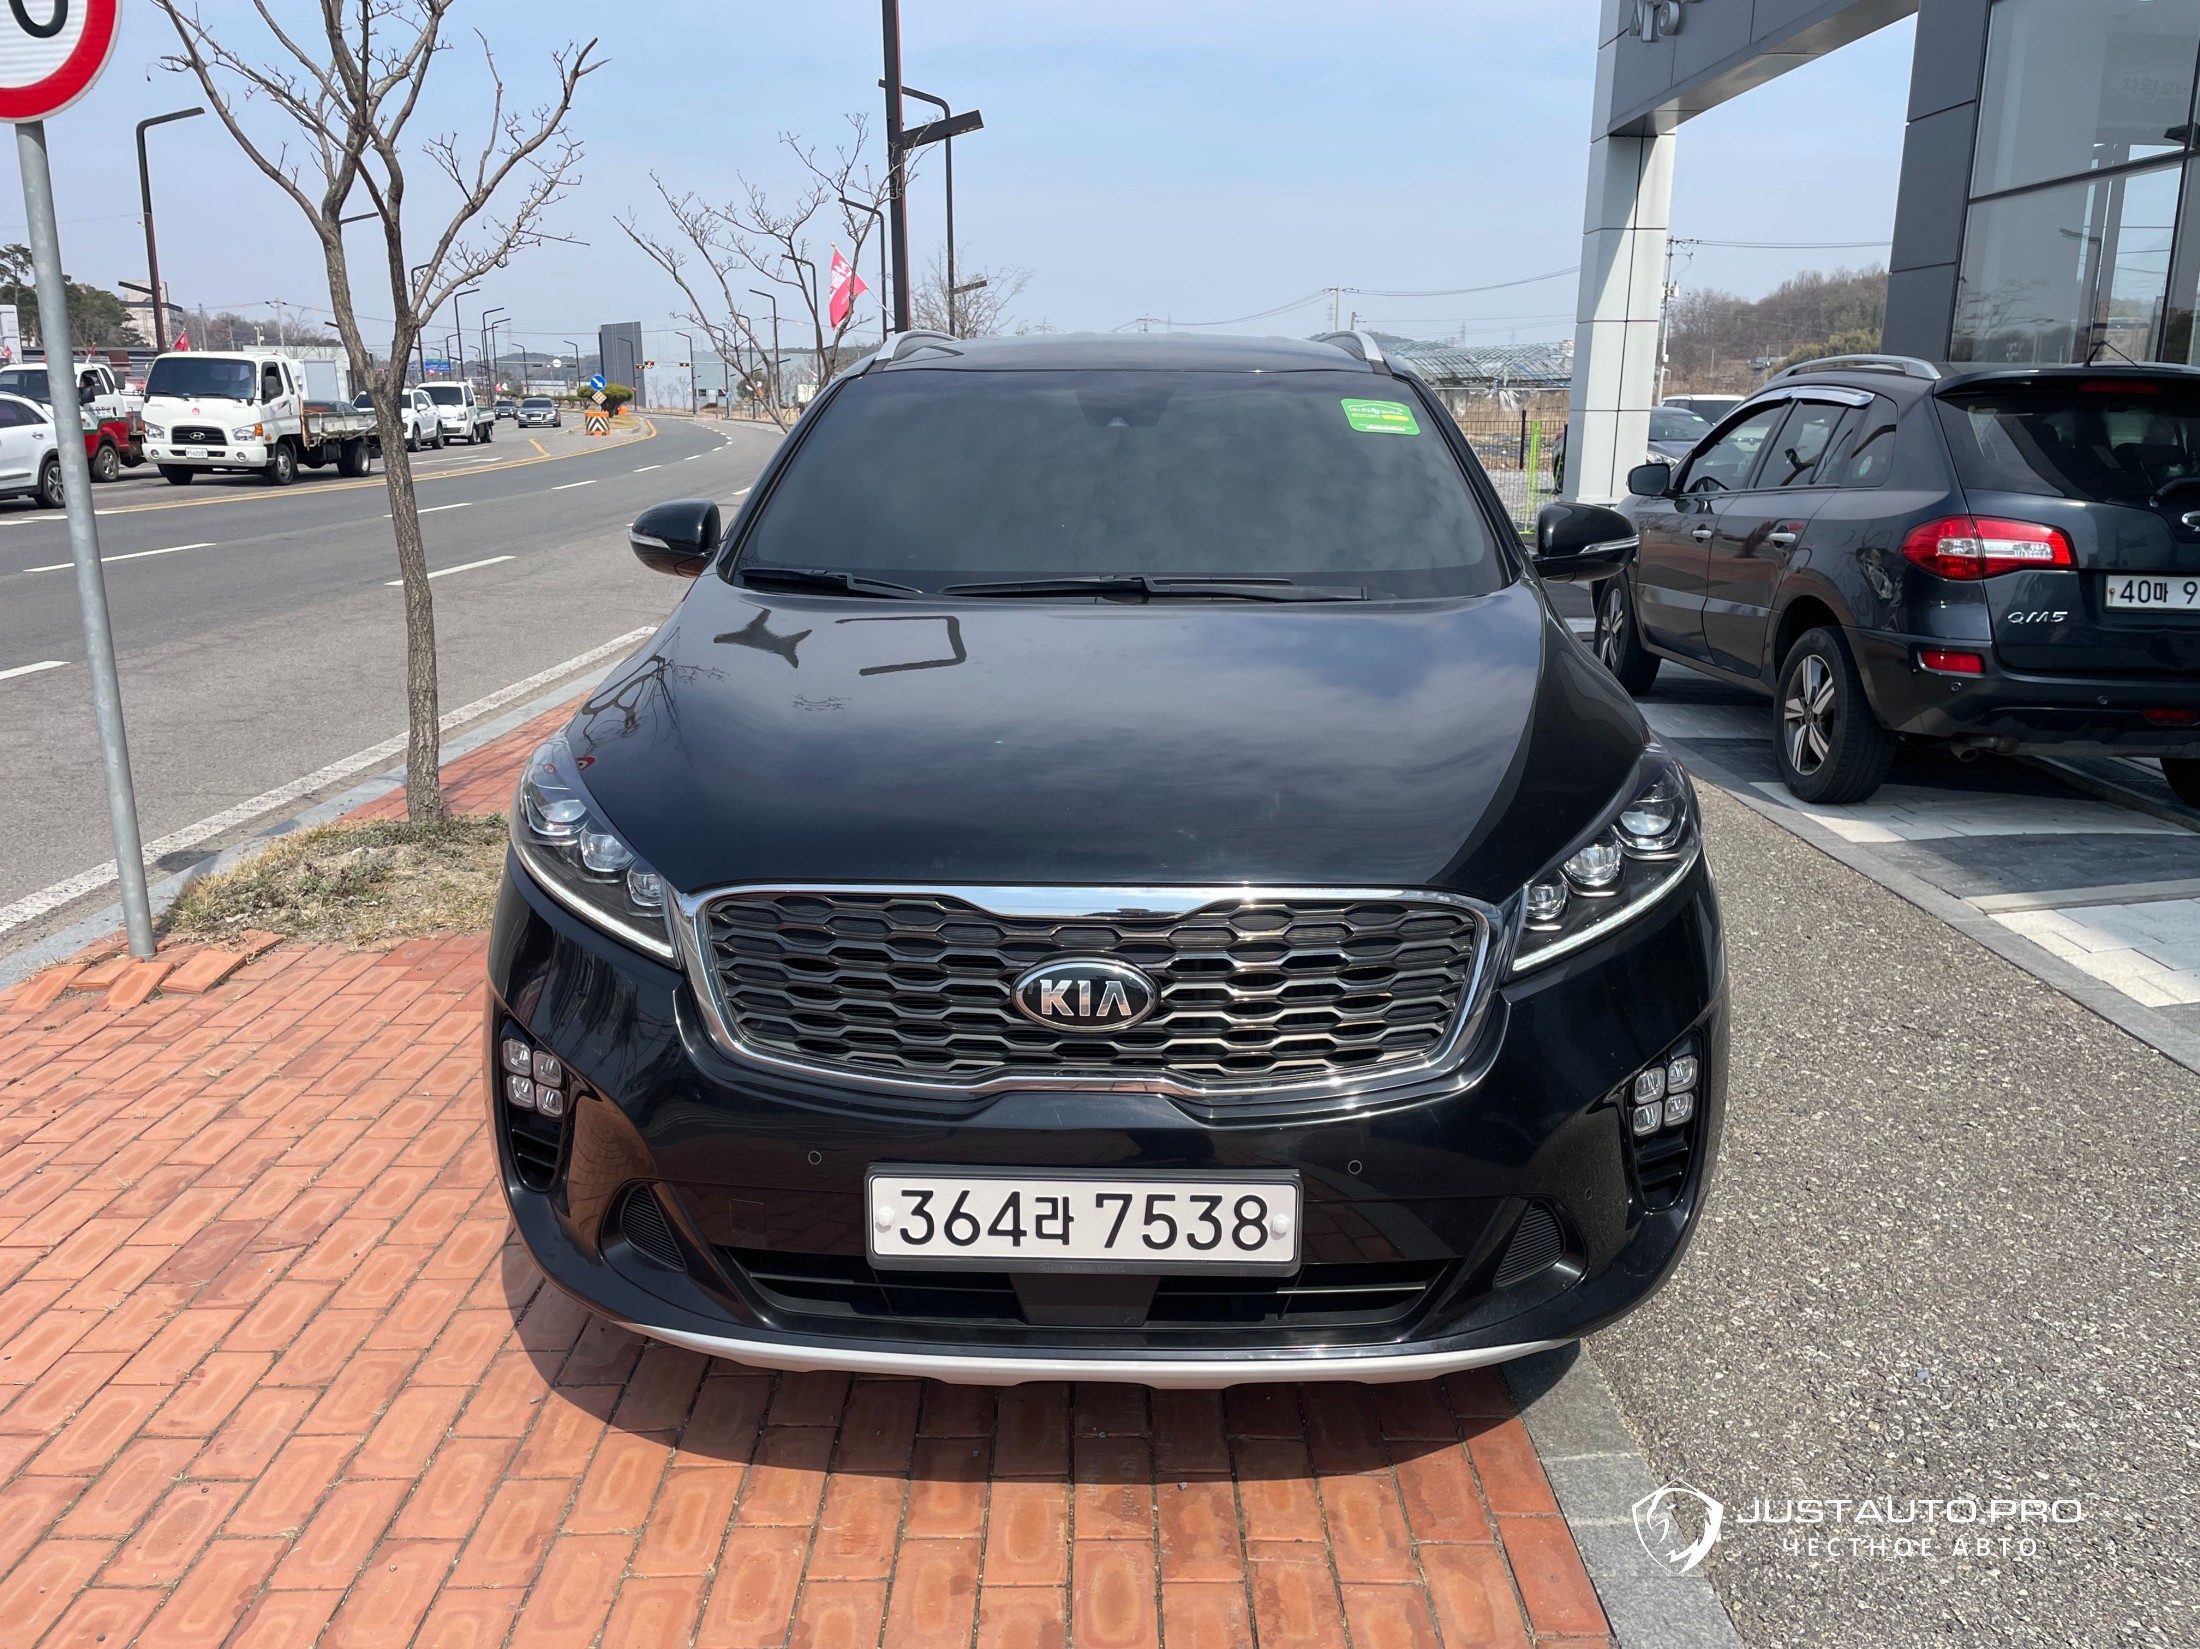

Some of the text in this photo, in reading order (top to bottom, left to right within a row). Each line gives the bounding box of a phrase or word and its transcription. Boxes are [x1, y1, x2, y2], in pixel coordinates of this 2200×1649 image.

[2120, 580, 2168, 603] 40마
[2007, 611, 2068, 624] QM5
[1040, 979, 1132, 1016] KIA
[900, 1190, 1269, 1251] 364라 7538
